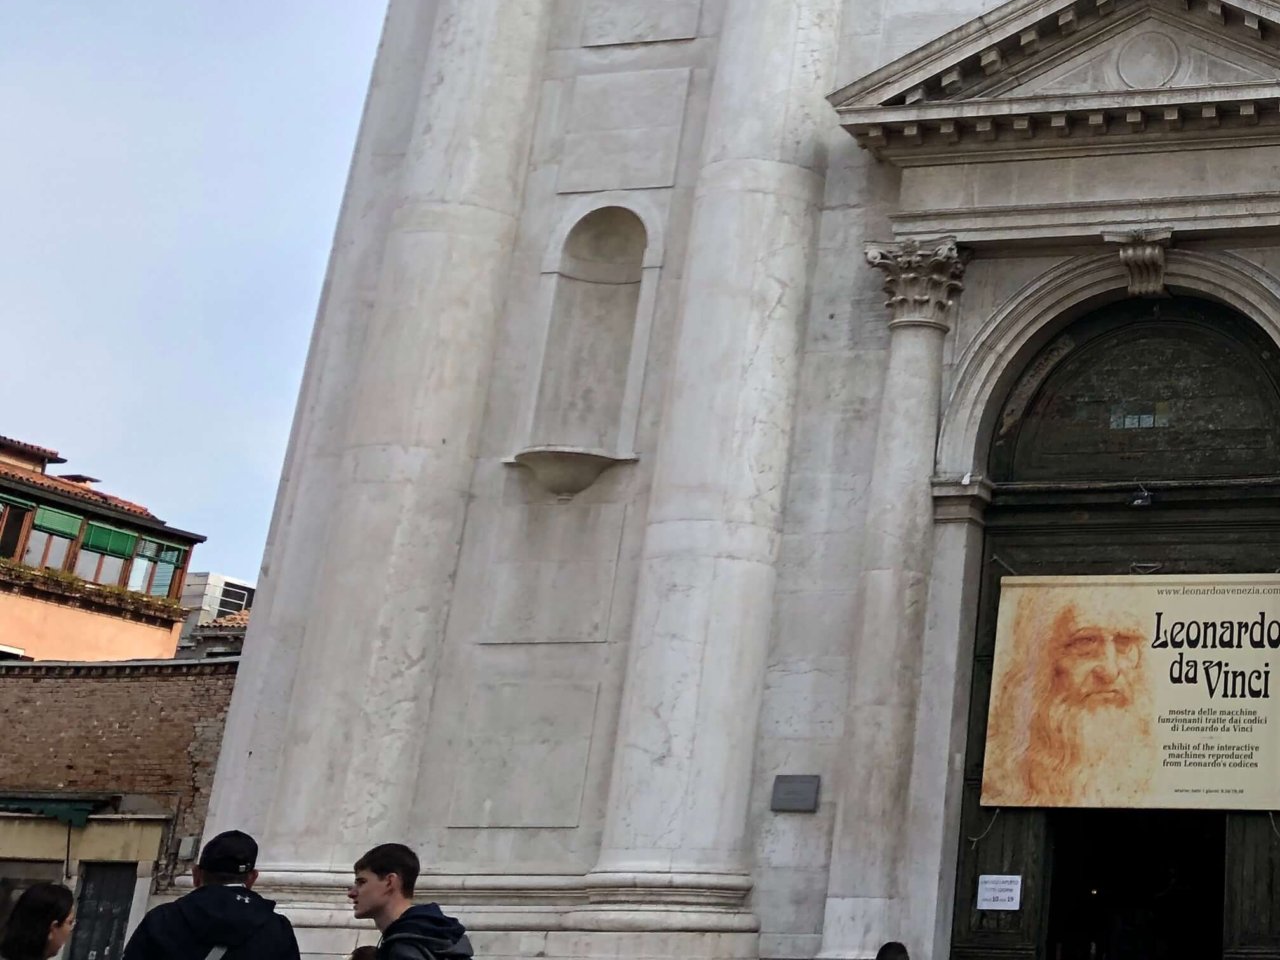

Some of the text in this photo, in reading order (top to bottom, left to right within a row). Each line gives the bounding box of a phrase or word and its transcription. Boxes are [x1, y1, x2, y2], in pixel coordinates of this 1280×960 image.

[1169, 652, 1271, 699] da Vinci
[1197, 707, 1217, 716] delle
[1219, 708, 1257, 716] macchine
[1157, 716, 1203, 724] funzionanti
[1228, 716, 1241, 724] dai
[1243, 716, 1267, 724] codici
[1170, 724, 1179, 732] di
[1181, 724, 1219, 732] Leonardo
[1232, 724, 1253, 732] Vinci
[1162, 742, 1260, 752] exhibit of the interactive
[1168, 751, 1254, 761] machines reproduced
[1162, 759, 1259, 768] from Leonardo's codices
